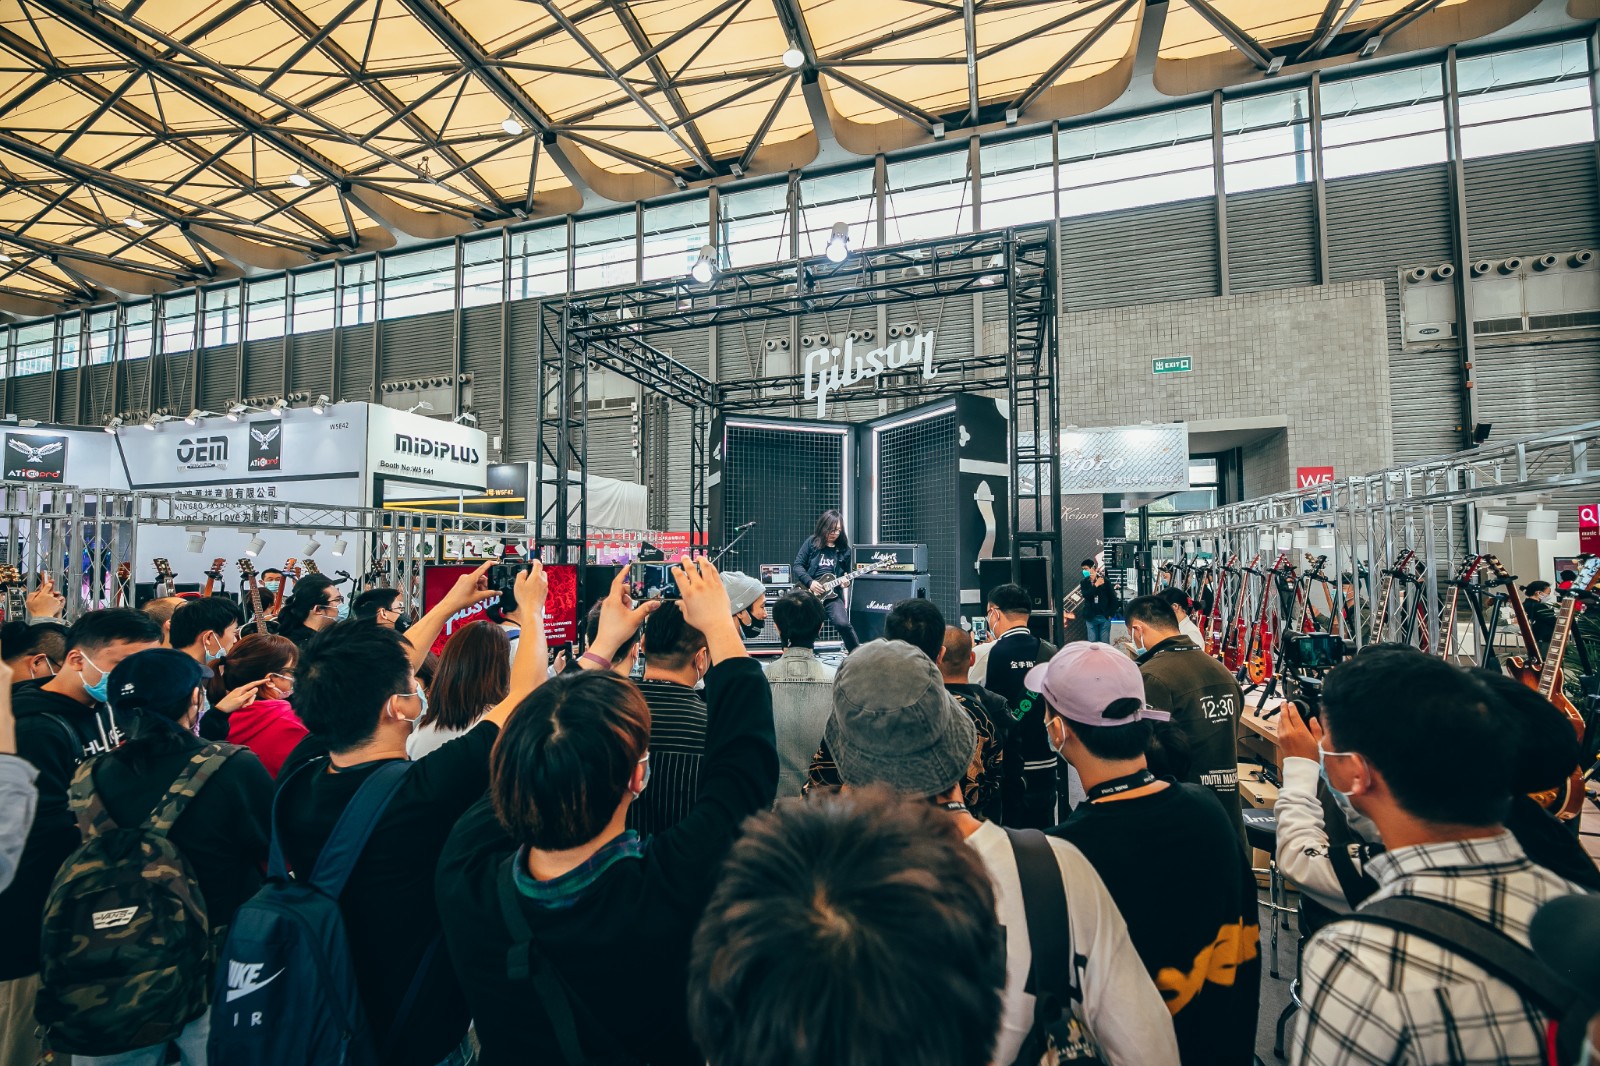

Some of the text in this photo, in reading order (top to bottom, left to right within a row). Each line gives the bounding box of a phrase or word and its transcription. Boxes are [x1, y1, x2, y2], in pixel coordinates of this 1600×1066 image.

[1155, 361, 1164, 370] 出
[1181, 360, 1189, 368] 口
[804, 331, 938, 419] Gibson
[177, 435, 228, 463] OEM
[380, 460, 399, 469] Booth
[871, 551, 897, 561] Marshall
[866, 600, 893, 611] Marshall
[1201, 698, 1234, 719] 12:30
[1200, 774, 1221, 785] YOUTH
[101, 910, 128, 920] VANS
